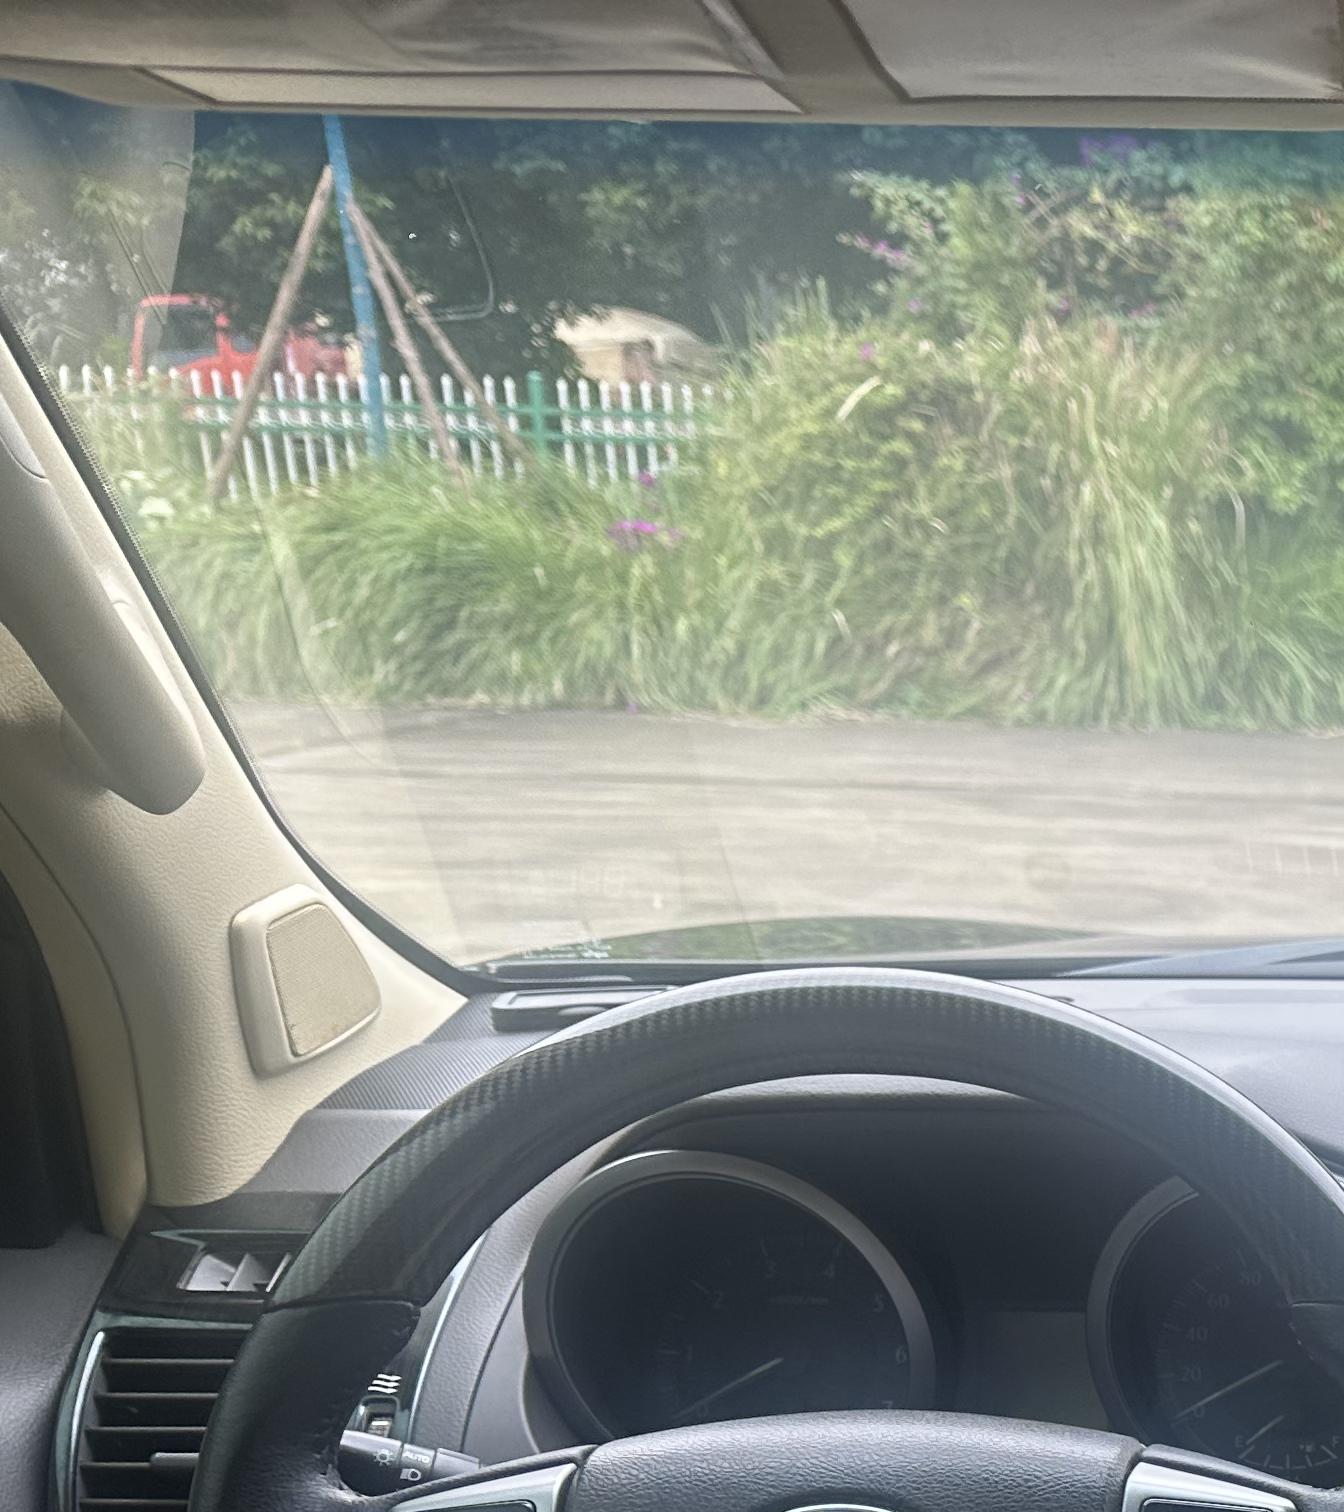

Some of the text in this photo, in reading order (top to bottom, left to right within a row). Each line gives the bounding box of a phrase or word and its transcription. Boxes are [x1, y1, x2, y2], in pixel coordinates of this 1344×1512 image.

[1206, 1293, 1230, 1310] 60
[1185, 1327, 1209, 1342] 40
[1181, 1366, 1203, 1382] 20
[403, 1450, 430, 1464] AUTO
